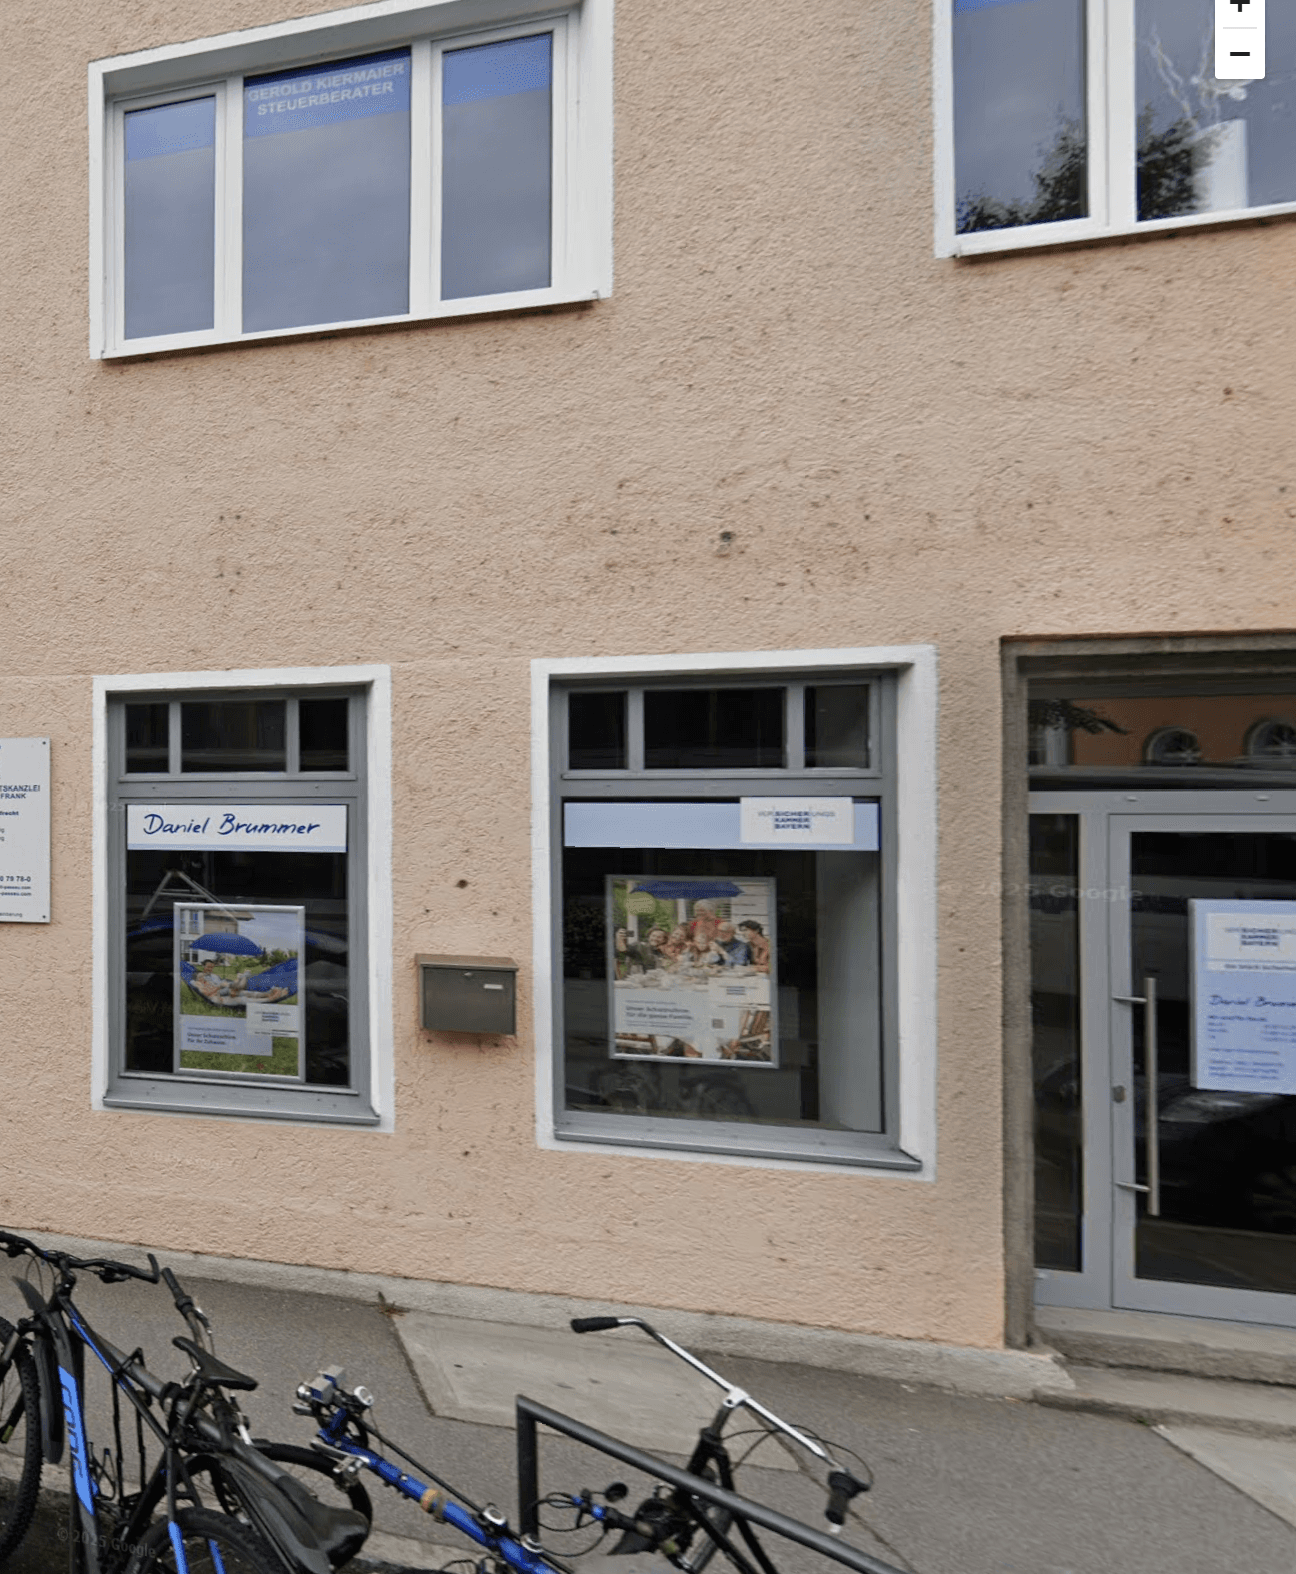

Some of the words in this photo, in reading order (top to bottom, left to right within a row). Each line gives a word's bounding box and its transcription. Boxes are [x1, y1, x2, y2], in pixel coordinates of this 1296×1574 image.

[248, 81, 312, 101] GEROLD
[316, 63, 405, 90] KIERMAIER
[257, 82, 394, 115] STEUERBERATER
[143, 814, 210, 835] Daniel
[218, 813, 320, 835] Brummer
